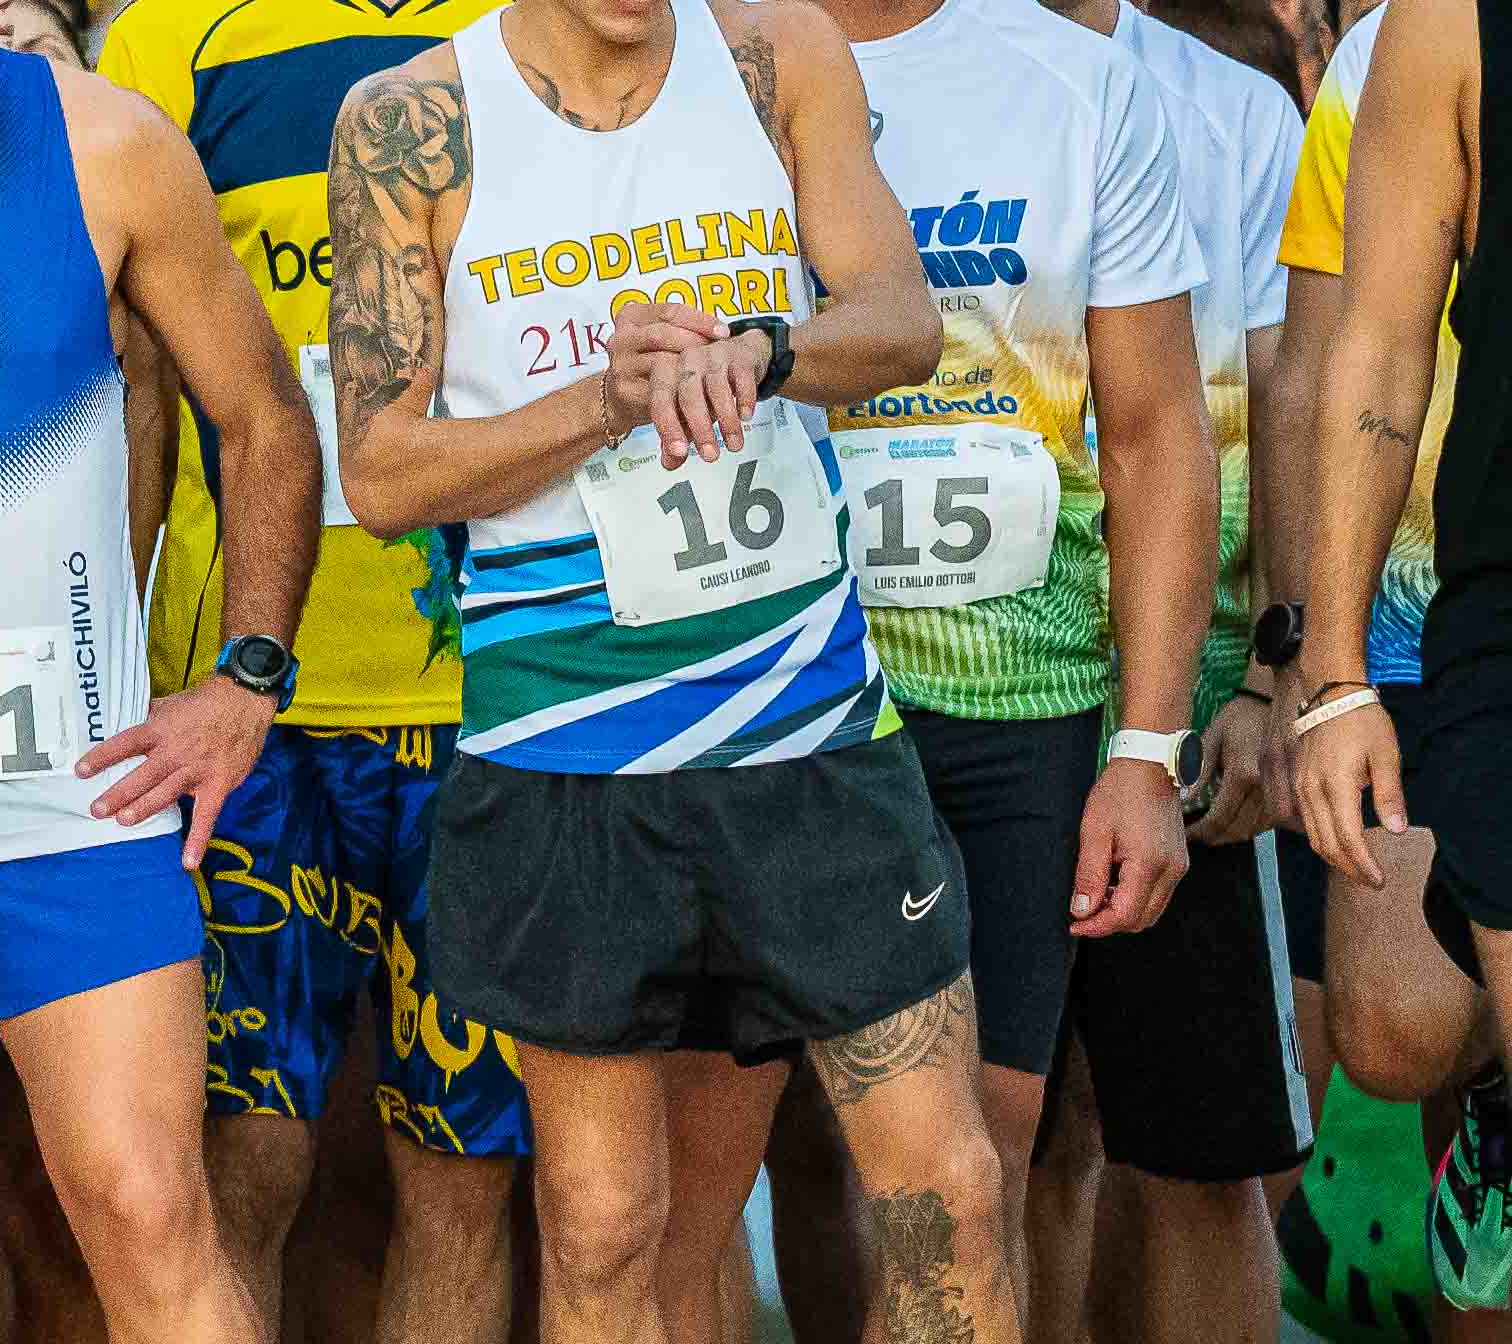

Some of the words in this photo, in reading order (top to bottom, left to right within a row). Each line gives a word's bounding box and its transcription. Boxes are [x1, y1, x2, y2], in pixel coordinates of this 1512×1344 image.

[259, 228, 333, 292] be
[467, 207, 799, 304] TEODELINA
[657, 459, 784, 572] 16
[864, 476, 991, 568] 15
[730, 560, 771, 583] LEANDRO
[875, 575, 897, 590] LUIS
[899, 574, 934, 589] EMILIO
[63, 551, 106, 743] matiCHIVILÓ
